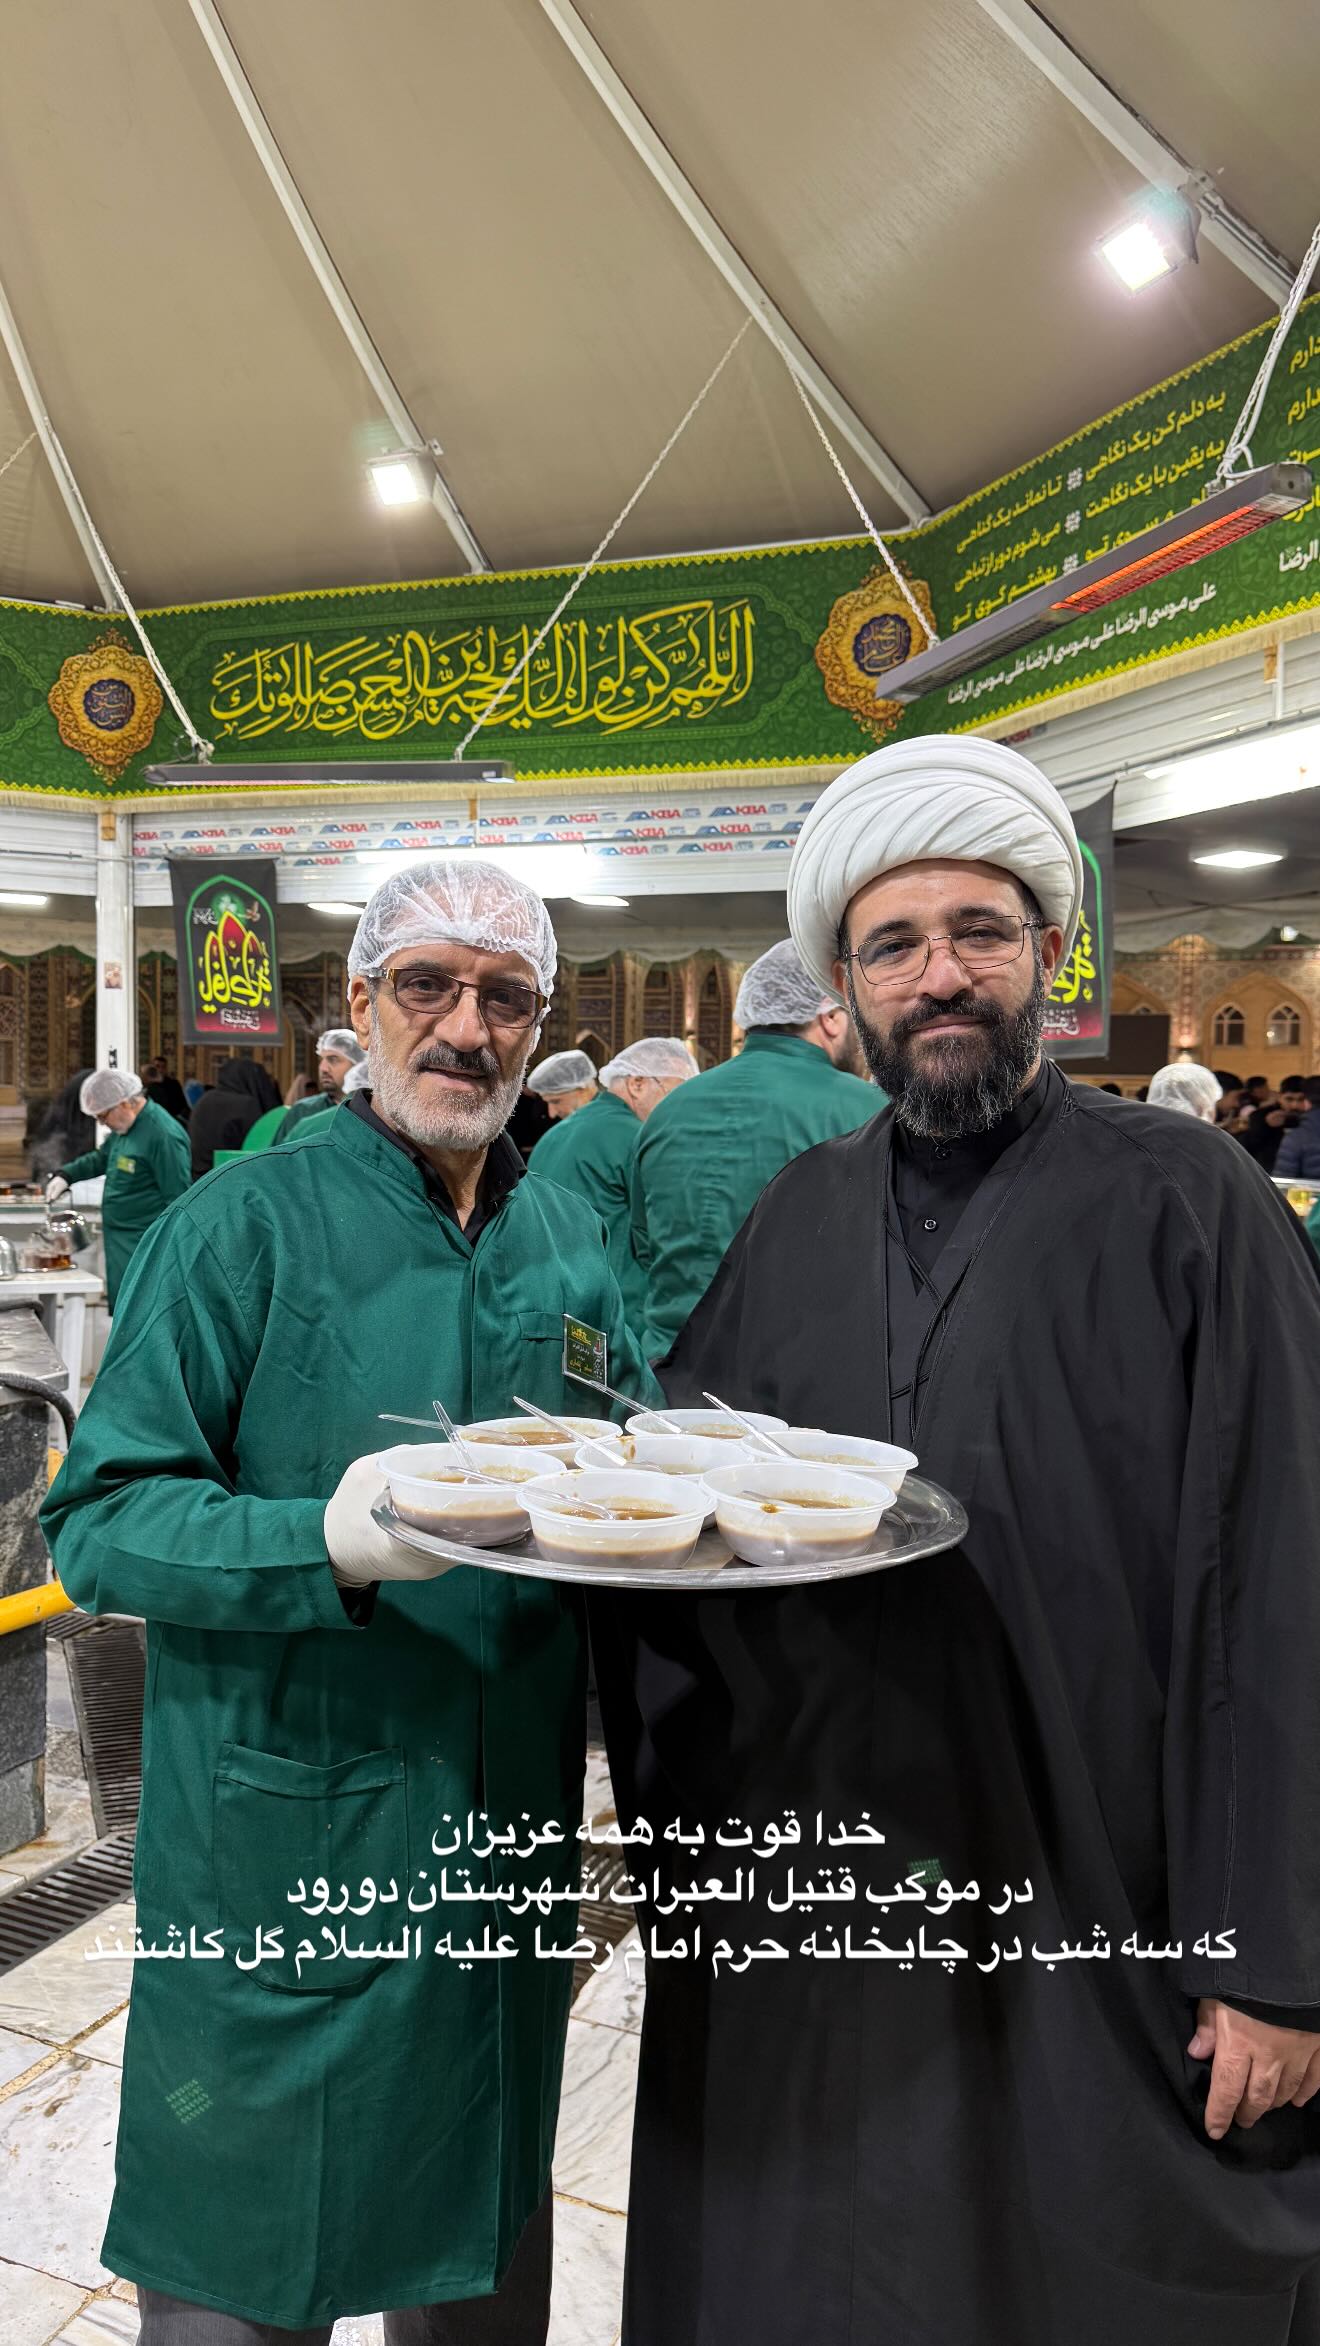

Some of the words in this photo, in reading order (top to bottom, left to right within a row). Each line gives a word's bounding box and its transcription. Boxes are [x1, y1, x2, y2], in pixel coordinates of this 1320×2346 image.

[1176, 399, 1204, 434] دلم
[1206, 391, 1226, 412] به
[1152, 410, 1177, 446] کن
[1086, 440, 1127, 481] نگاهی
[1168, 446, 1204, 483] یقین
[1206, 439, 1225, 460] به
[1086, 481, 1129, 518] نگاهت
[1146, 596, 1187, 629] موسی
[1188, 582, 1217, 613] علی
[1115, 605, 1148, 636] الرضا
[1052, 635, 1090, 664] موسی
[1090, 622, 1116, 650] علی
[1005, 658, 1026, 684] علی
[1025, 644, 1054, 673] الرضا
[947, 679, 973, 705] الرضا
[972, 671, 1005, 698] موسی
